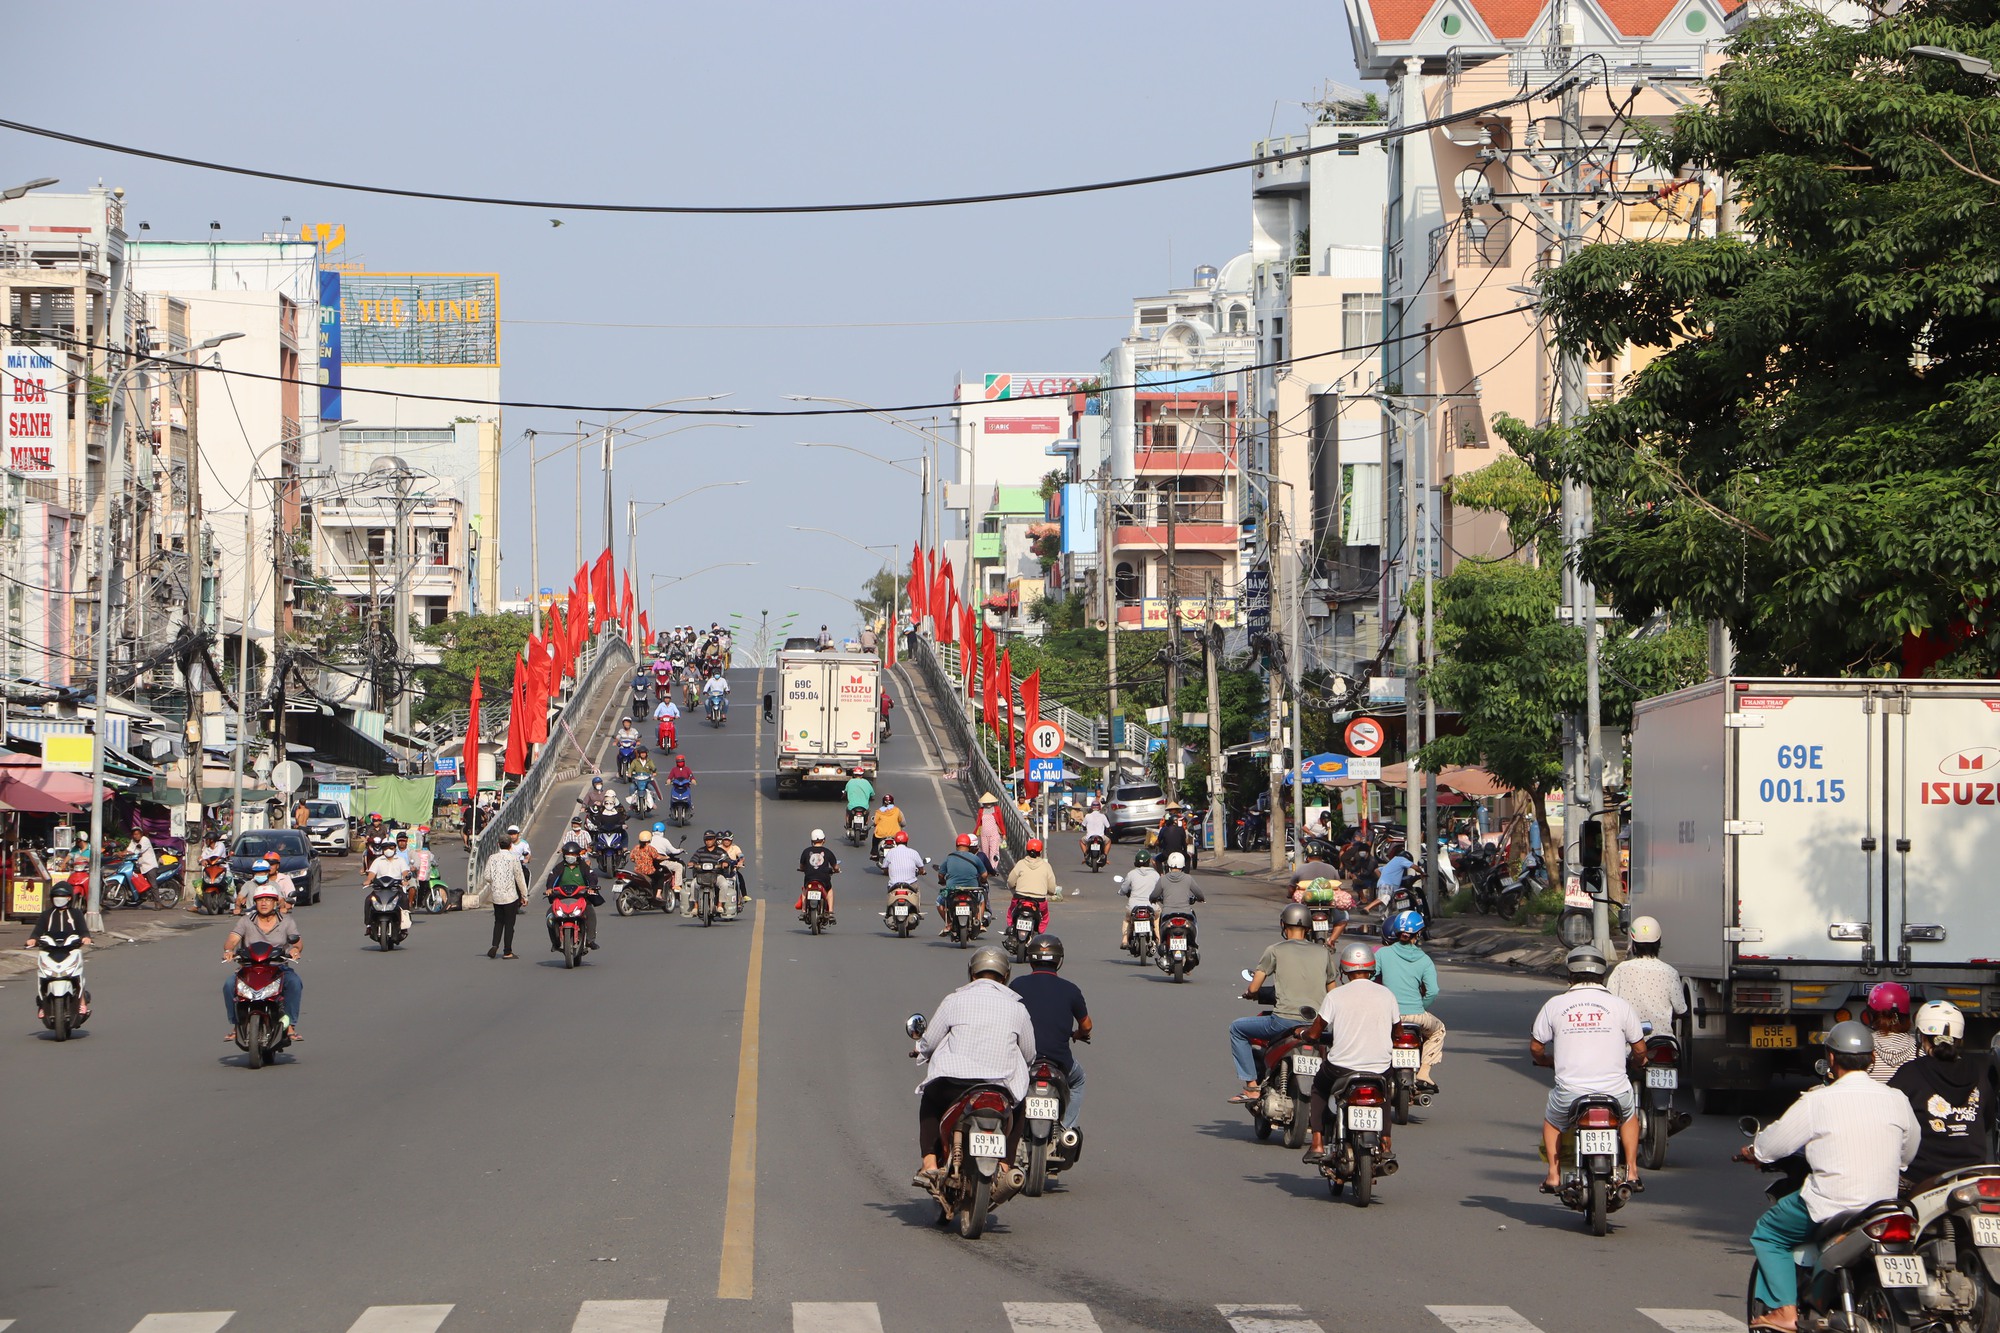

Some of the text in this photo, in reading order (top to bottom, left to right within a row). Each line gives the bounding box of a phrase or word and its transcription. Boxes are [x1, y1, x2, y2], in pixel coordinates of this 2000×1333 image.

[417, 300, 481, 322] MINH
[13, 372, 46, 403] HÒA
[9, 412, 51, 437] SANH
[10, 447, 51, 471] MINH
[794, 680, 812, 688] 69C
[841, 686, 872, 694] ISUZU
[789, 691, 819, 700] 059.04
[1777, 744, 1824, 769] 69E
[1031, 768, 1061, 780] CÀ MAU
[1760, 779, 1846, 803] 001.15
[1921, 782, 2000, 805] ISUZ
[1763, 1027, 1784, 1036] 69E
[1756, 1038, 1793, 1047] 001.15
[1030, 1098, 1054, 1108] 69-B1
[1028, 1108, 1057, 1117] 166.18
[1353, 1109, 1377, 1119] 69-K2
[1955, 1114, 1976, 1122] LAND
[1354, 1120, 1378, 1129] 4697
[975, 1134, 1000, 1143] 69-N1
[1585, 1132, 1611, 1141] 69-F1
[973, 1145, 1003, 1155] 117.44
[1586, 1143, 1612, 1152] 5162
[1883, 1258, 1919, 1270] 69-U1
[1888, 1271, 1922, 1284] 4262
